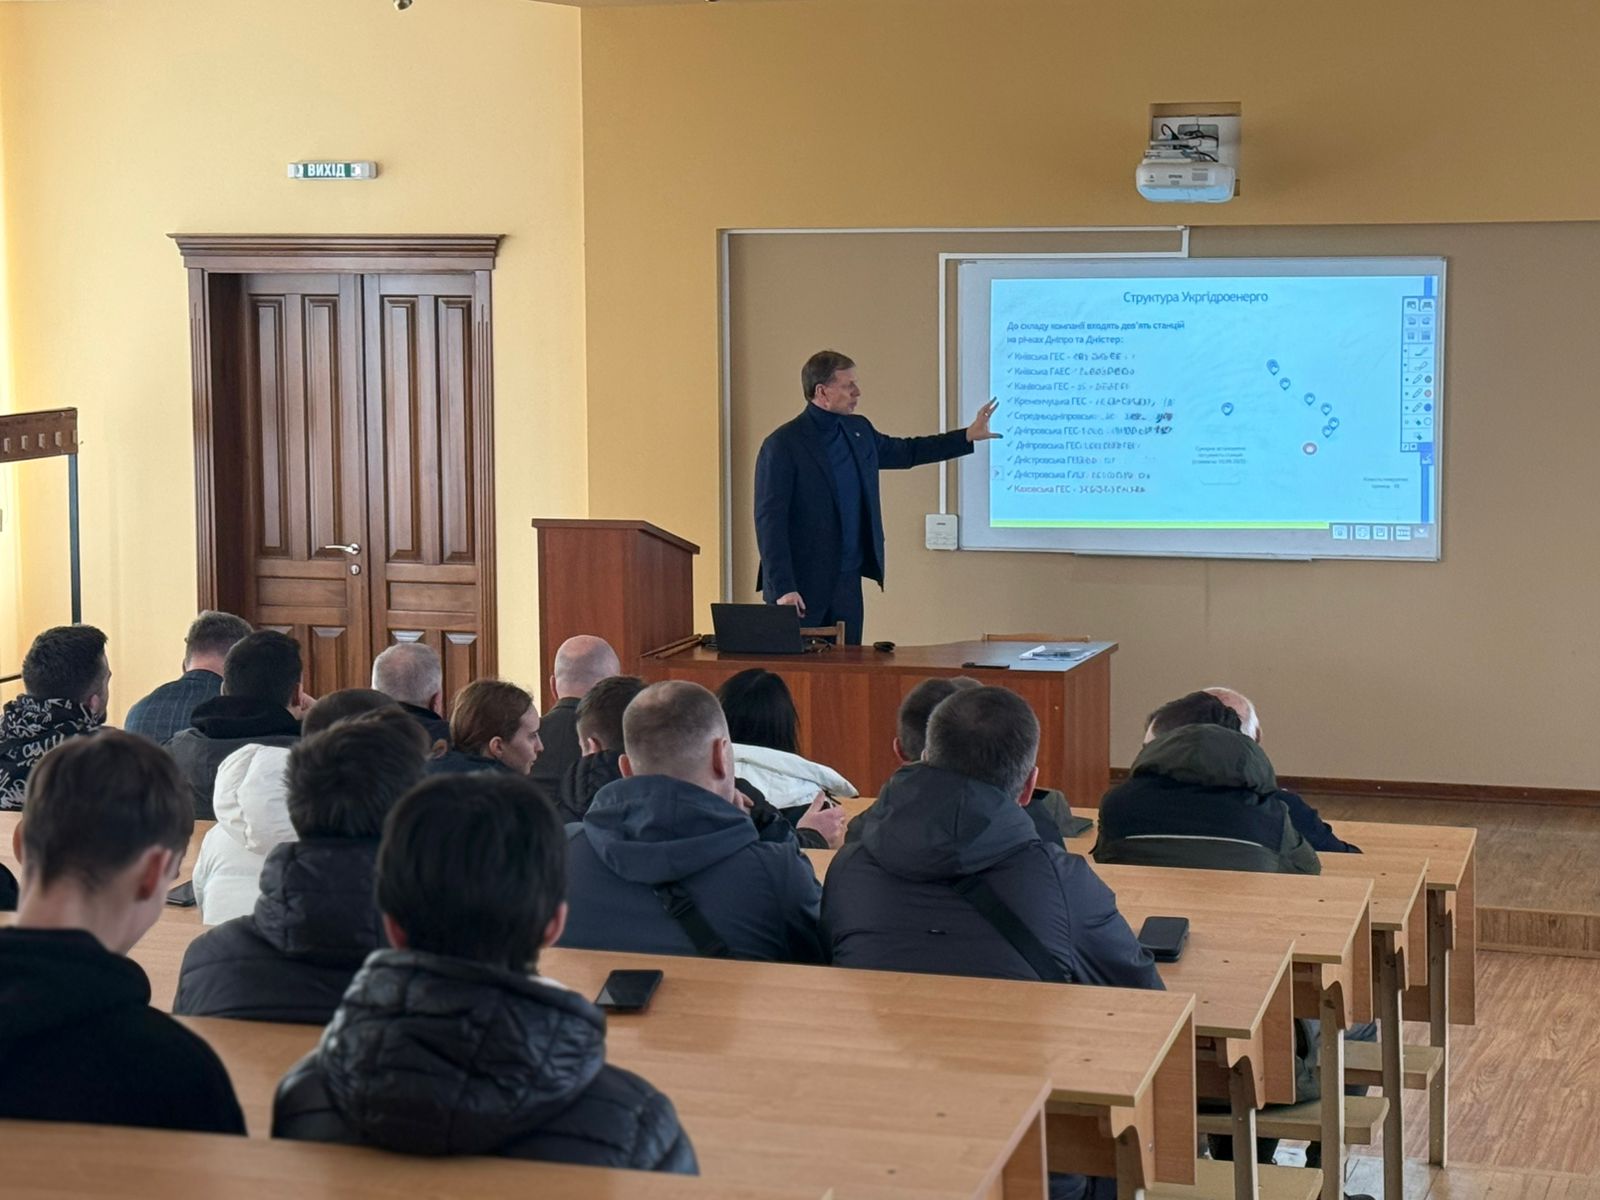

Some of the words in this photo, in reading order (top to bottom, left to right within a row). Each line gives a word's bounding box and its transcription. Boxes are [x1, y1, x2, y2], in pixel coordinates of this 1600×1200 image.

[307, 163, 346, 178] ВИХІД
[1123, 291, 1179, 305] Структура
[1181, 291, 1269, 305] Укргідроенерго
[1007, 321, 1019, 332] До
[1086, 323, 1120, 331] входять
[1152, 320, 1185, 331] станцій
[1044, 335, 1074, 345] Дніпро
[1075, 336, 1084, 344] та
[1085, 335, 1125, 345] Дністер:
[1049, 352, 1065, 361] ГЕС
[1049, 367, 1071, 376] ГАЕС
[1053, 382, 1069, 391] ГЕС
[1071, 397, 1087, 406] ГЕС
[1055, 485, 1071, 493] ГЕС
